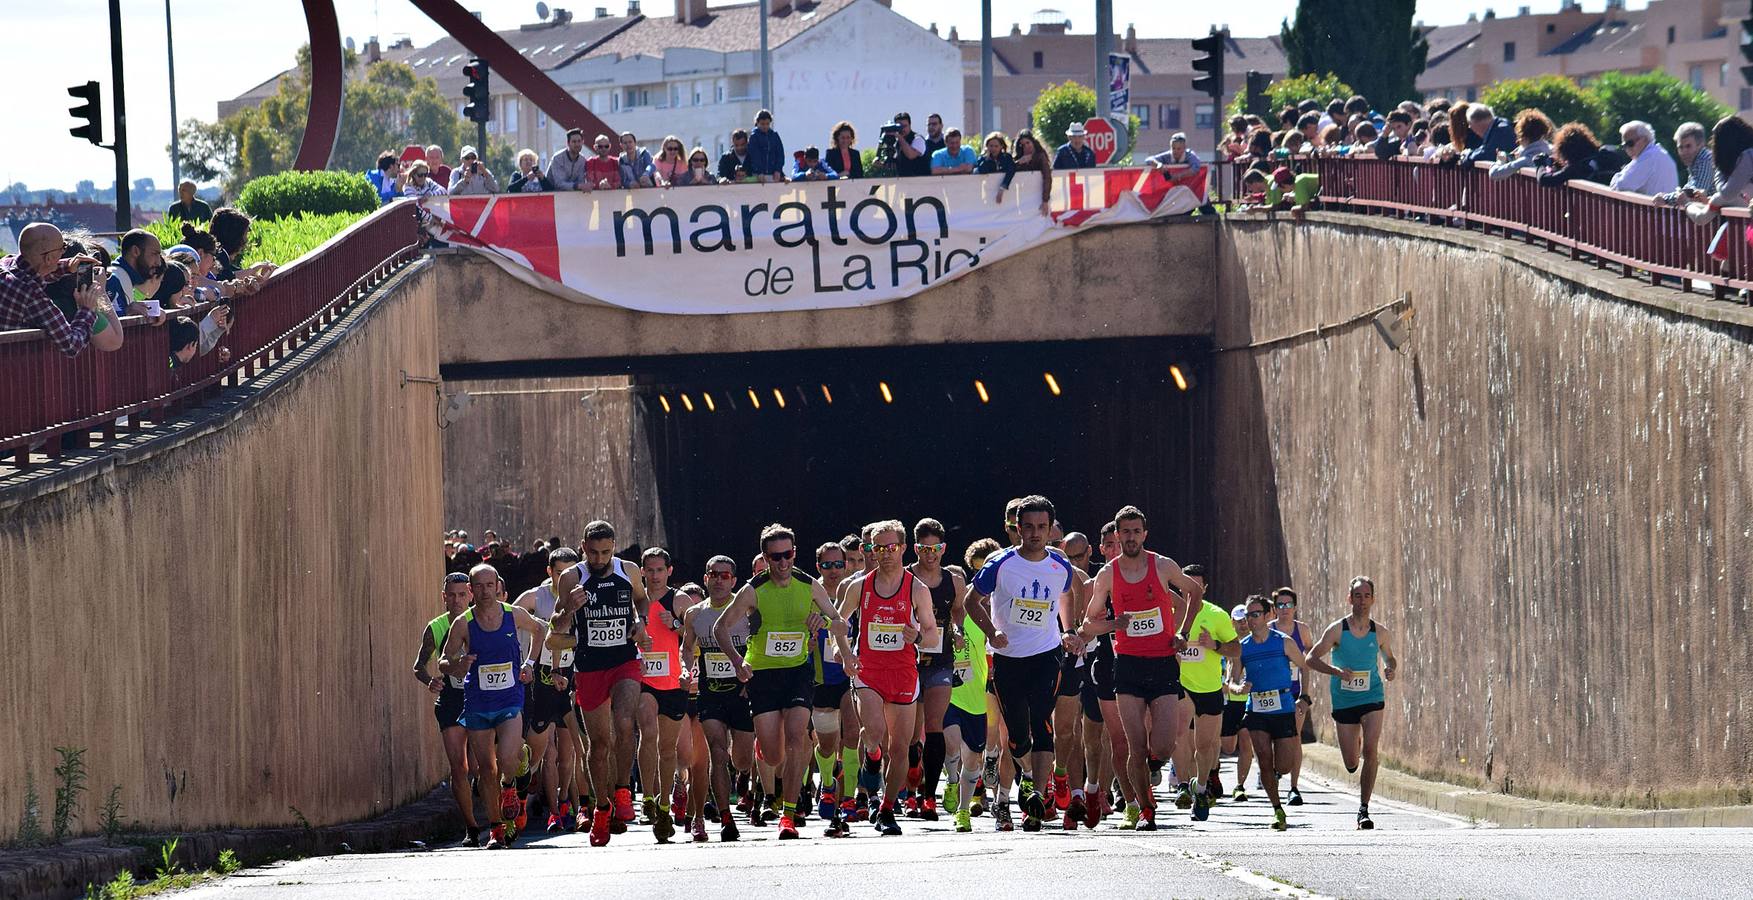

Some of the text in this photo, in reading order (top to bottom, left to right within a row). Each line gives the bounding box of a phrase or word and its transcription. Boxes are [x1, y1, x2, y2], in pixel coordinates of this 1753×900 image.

[1085, 132, 1114, 151] TOP
[613, 184, 949, 257] maratón
[744, 236, 986, 297] de La Rio
[1019, 608, 1043, 622] 792
[1132, 619, 1155, 631] 856
[591, 628, 623, 642] 2089
[875, 633, 898, 645] 464
[774, 641, 797, 652] 852
[711, 661, 731, 672] 782
[487, 672, 507, 684] 972
[1259, 698, 1275, 708] 198
